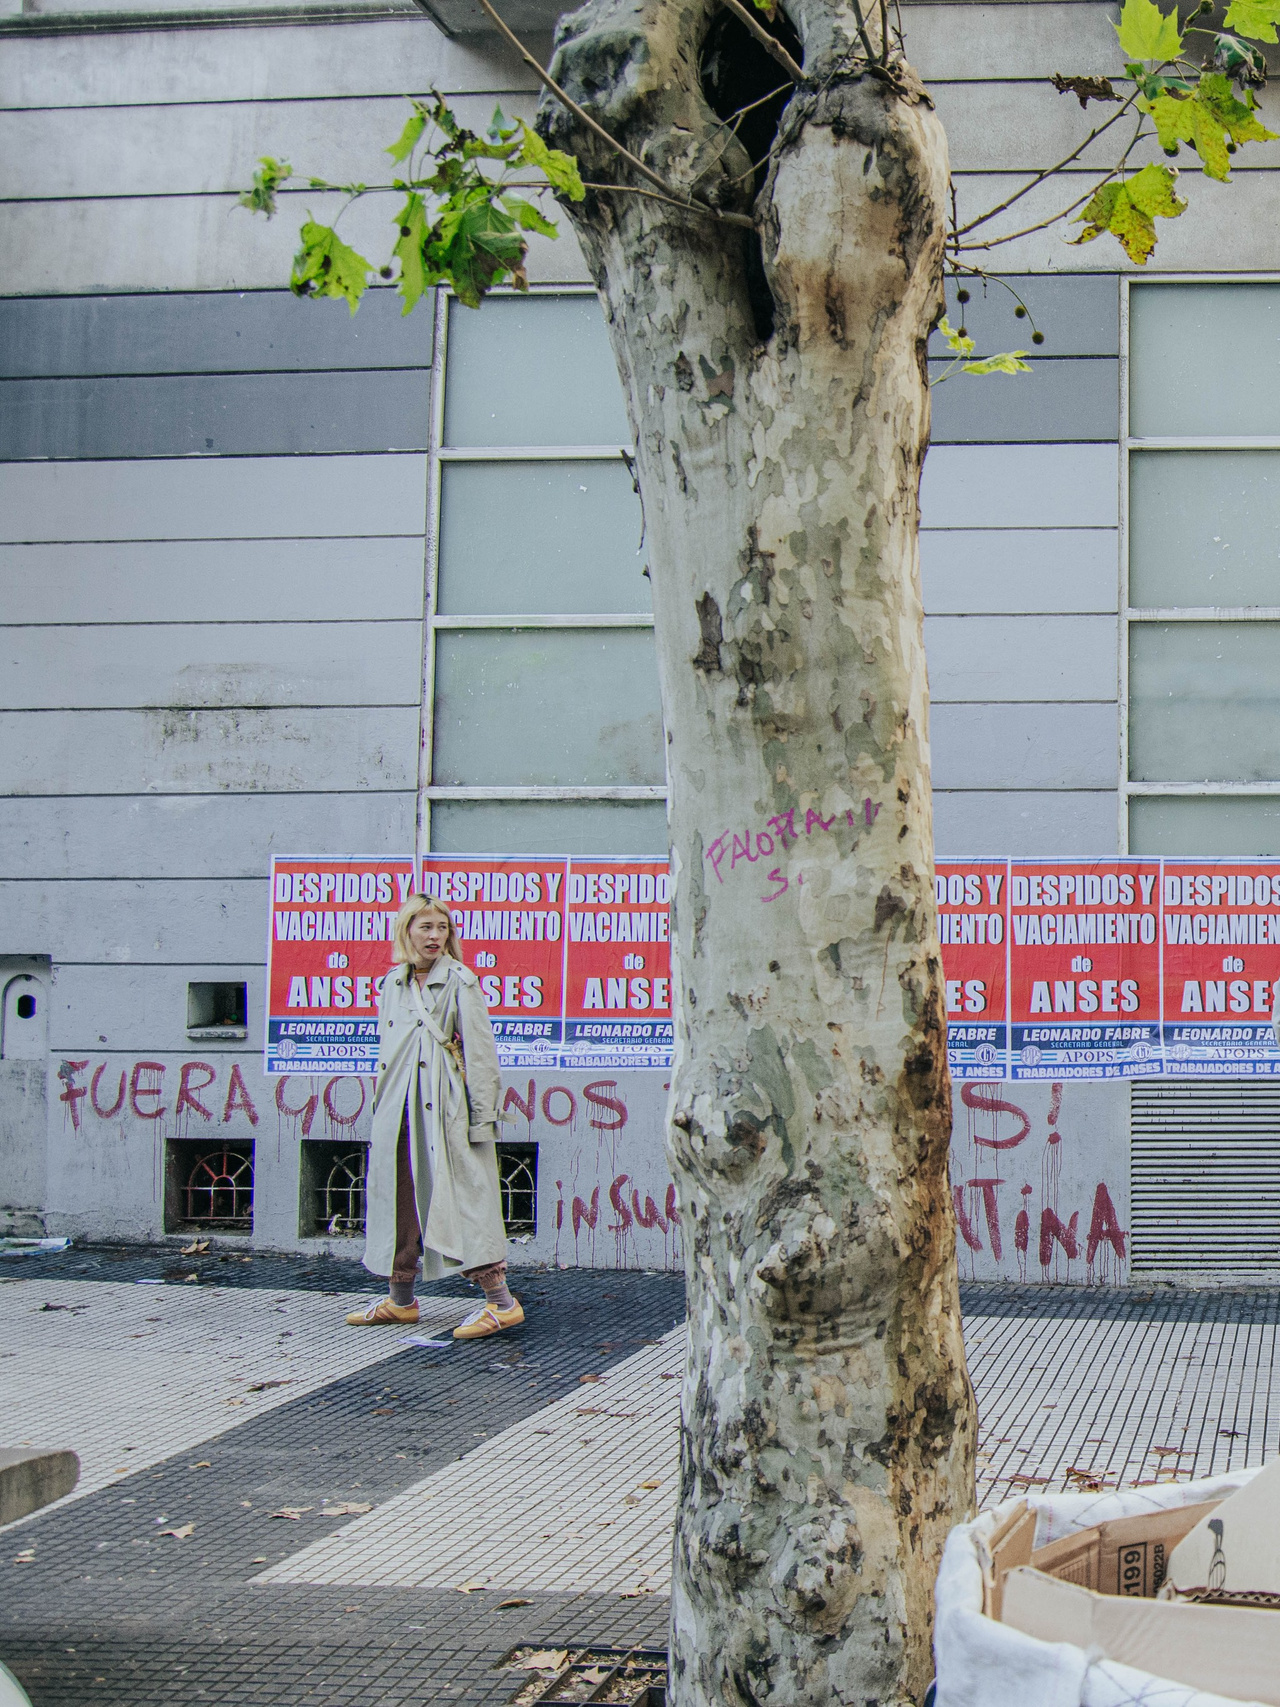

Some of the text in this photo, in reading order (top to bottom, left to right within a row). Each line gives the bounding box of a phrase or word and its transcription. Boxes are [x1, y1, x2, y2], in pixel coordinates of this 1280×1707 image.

[276, 873, 413, 903] DESPIDOS Y
[425, 872, 561, 902] DESPIDOS Y
[570, 874, 669, 904] DESPIDO
[986, 875, 1003, 905] Y
[1012, 875, 1134, 906] DESPIDOS
[1138, 875, 1155, 905] Y
[275, 911, 398, 941] VACIAMIENT
[452, 910, 561, 941] CIAMIENTO
[570, 912, 669, 942] VACIAMIE
[1013, 914, 1155, 945] VACIAMIENTO
[328, 952, 348, 968] de
[476, 952, 496, 968] de
[624, 954, 644, 969] de
[1071, 956, 1092, 972] de
[1223, 956, 1243, 973] de
[482, 976, 543, 1008] SES
[583, 977, 669, 1009] ANSE
[1030, 980, 1138, 1013] ANSES
[280, 1023, 354, 1035] LEONARDO
[505, 1023, 552, 1035] FABRE
[576, 1025, 652, 1036] LEONARDO
[949, 1028, 996, 1040] FABRE
[1023, 1028, 1150, 1041] LEONARDO FABRE
[1174, 1028, 1252, 1040] LEONARDO
[316, 1046, 365, 1056] APOPS
[1062, 1051, 1114, 1062] APOPS
[1212, 1049, 1264, 1058] APOPS
[273, 1061, 353, 1071] TRABAJADORES
[355, 1061, 372, 1071] DE
[500, 1055, 553, 1066] DE ANSES
[651, 1056, 665, 1066] DE
[1166, 1063, 1253, 1073] TRABAJADORES
[1256, 1063, 1271, 1072] DE
[950, 1067, 1003, 1077] DE ANSES
[1017, 1063, 1160, 1078] TRABAJADORES DE ANSES
[57, 1059, 259, 1131] FUERA
